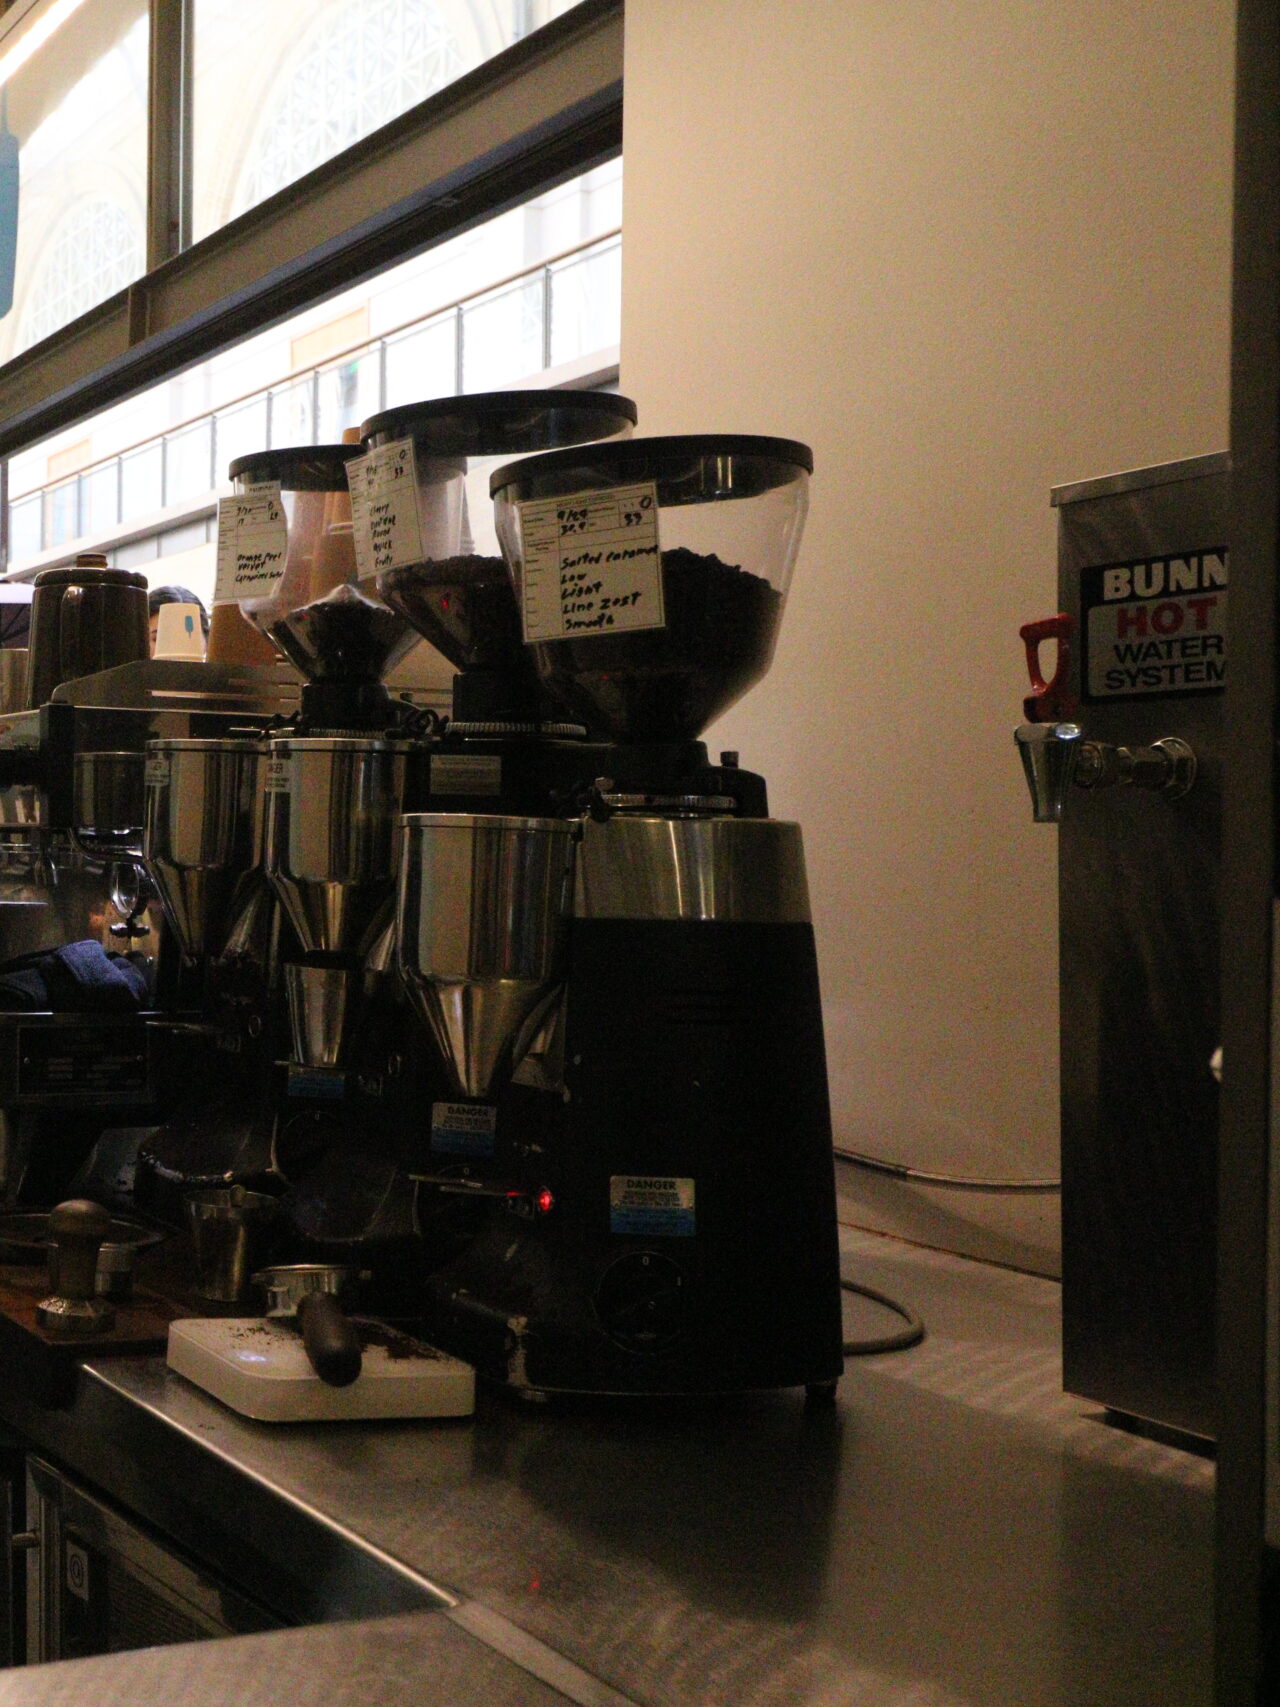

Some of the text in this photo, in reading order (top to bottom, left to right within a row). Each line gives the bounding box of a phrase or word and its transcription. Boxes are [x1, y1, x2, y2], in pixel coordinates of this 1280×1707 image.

[1103, 551, 1228, 601] BUNN
[1117, 597, 1218, 639] HOT
[1113, 635, 1223, 664] WATER
[627, 1179, 677, 1190] DANGER
